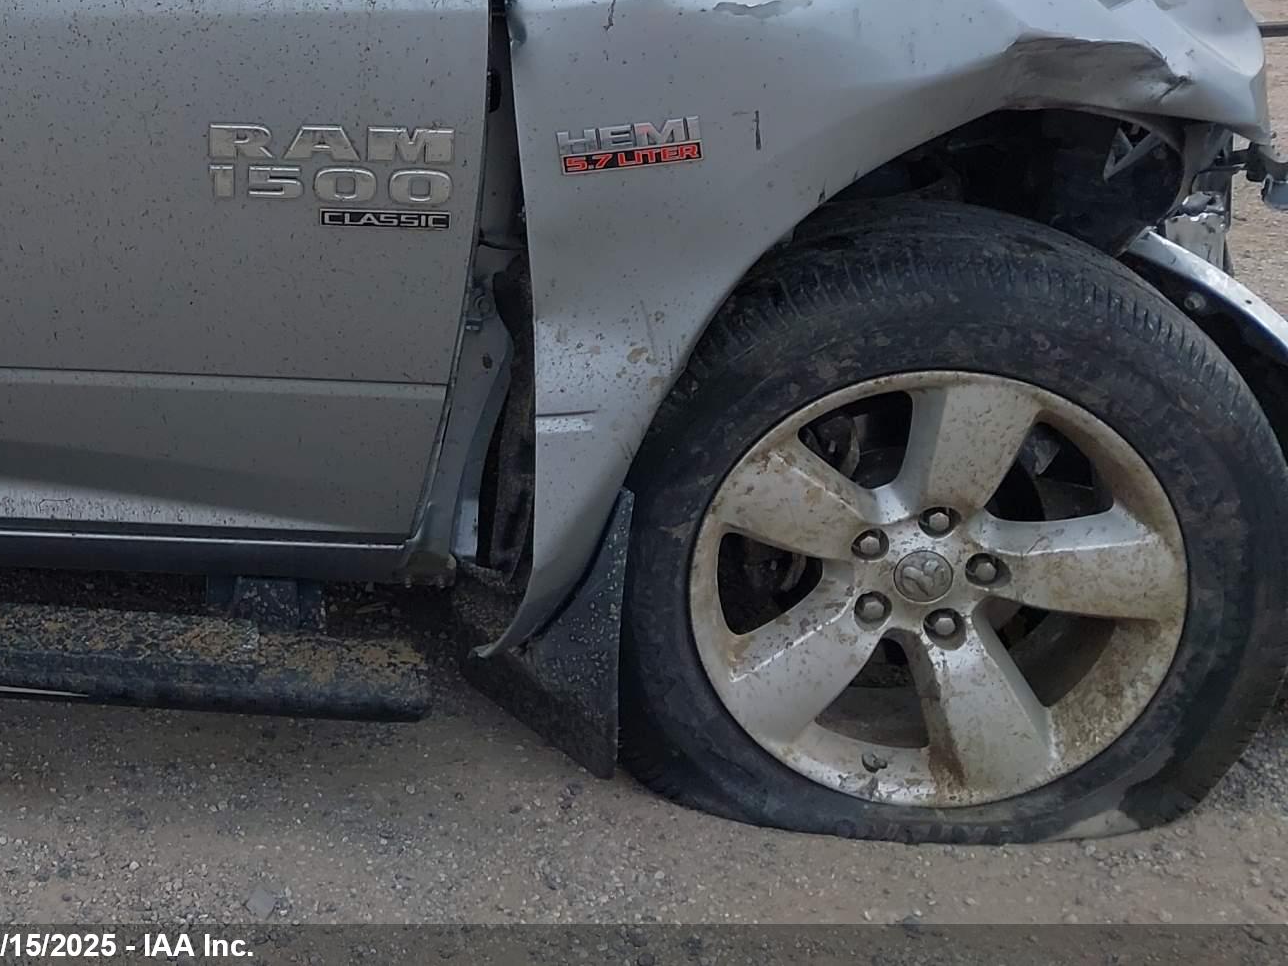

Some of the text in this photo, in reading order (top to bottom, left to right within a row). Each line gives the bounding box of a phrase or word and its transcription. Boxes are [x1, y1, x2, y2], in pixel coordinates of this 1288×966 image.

[209, 123, 455, 162] RAM
[557, 115, 700, 155] HEMI
[566, 144, 698, 171] 5.7 LITER
[209, 164, 453, 204] 1500
[323, 211, 449, 229] CLASSIC
